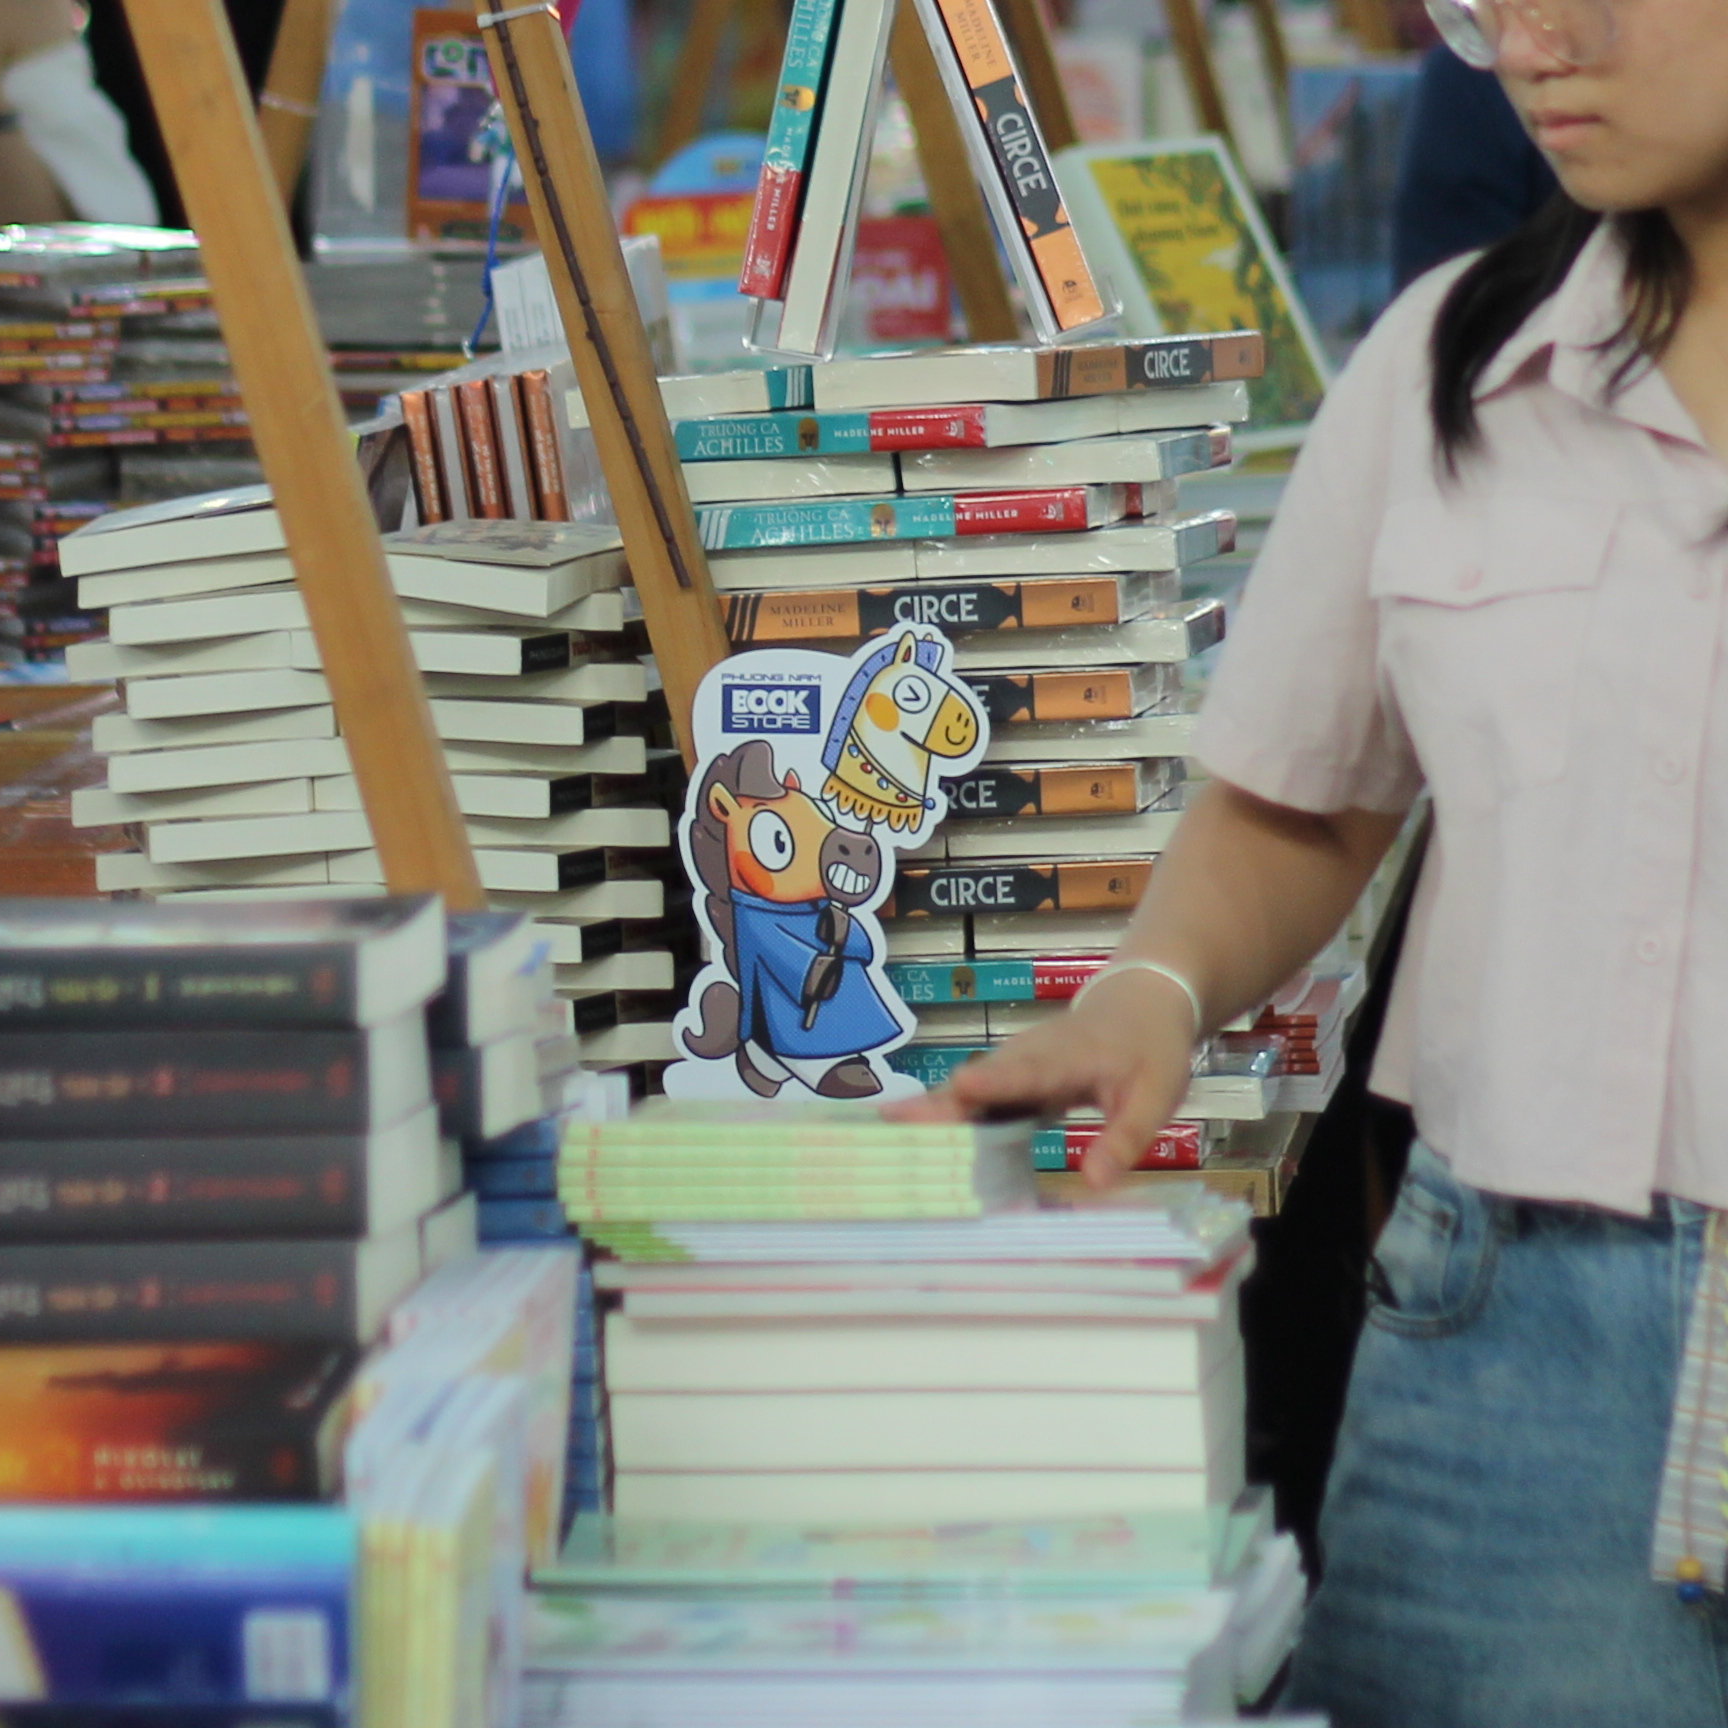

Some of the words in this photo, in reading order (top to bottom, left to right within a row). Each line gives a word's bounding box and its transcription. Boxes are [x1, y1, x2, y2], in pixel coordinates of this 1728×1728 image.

[995, 112, 1047, 197] CIRCE
[1144, 348, 1191, 379] CIRCE
[760, 422, 780, 435] CA
[887, 425, 926, 436] MILLER
[692, 436, 784, 456] ACHILLES
[827, 508, 851, 521] CA
[975, 509, 1019, 520] MILLER
[750, 522, 854, 545] ACHILLES
[769, 603, 846, 616] MADELINE
[894, 592, 979, 623] CIRCE
[782, 616, 835, 629] MILLER
[788, 674, 822, 682] NAM
[731, 689, 811, 714] BOOK
[731, 714, 811, 729] STORE
[941, 780, 998, 809] RCE
[930, 875, 1016, 907] CIRCE
[1054, 974, 1091, 985] MILLE
